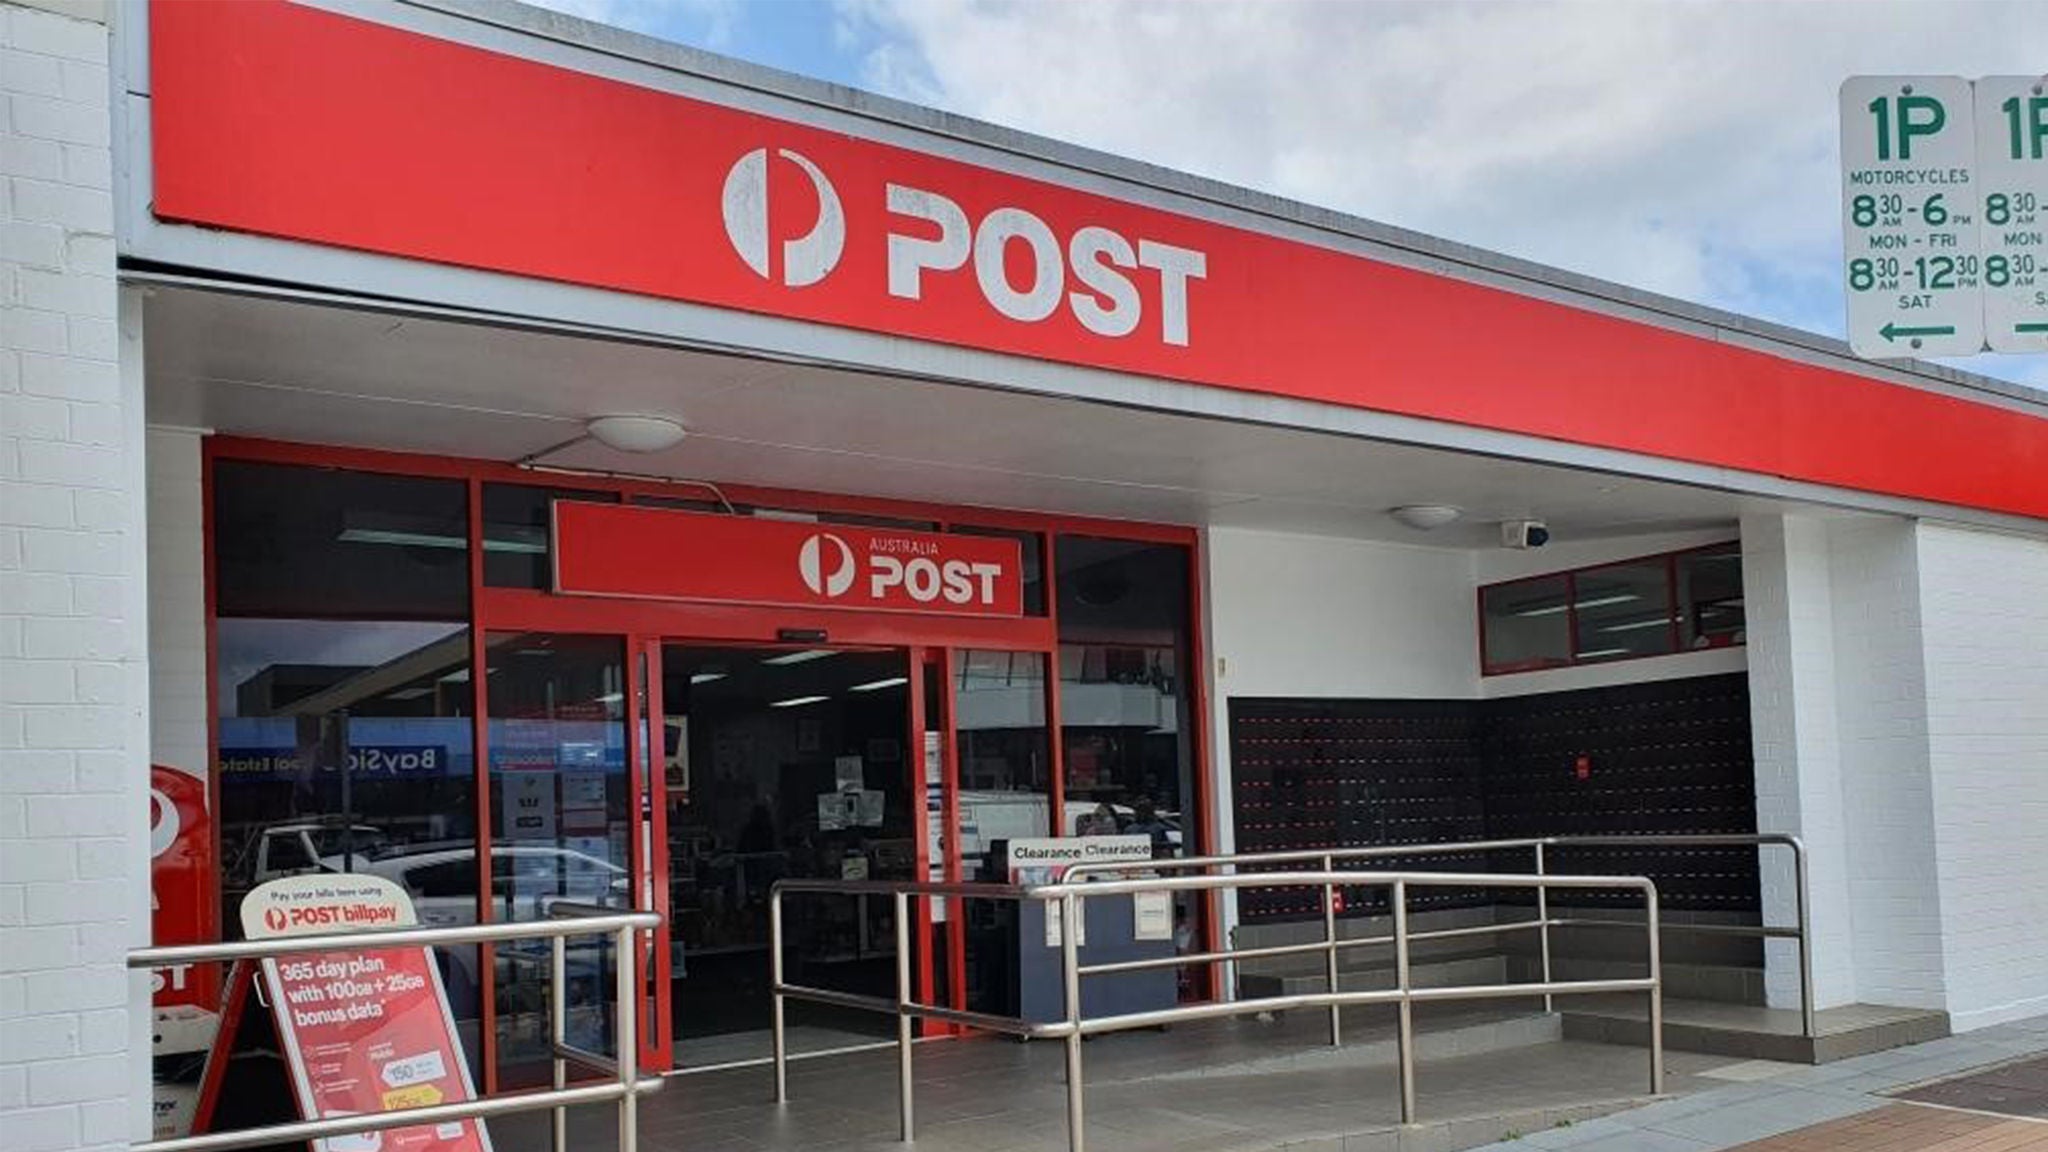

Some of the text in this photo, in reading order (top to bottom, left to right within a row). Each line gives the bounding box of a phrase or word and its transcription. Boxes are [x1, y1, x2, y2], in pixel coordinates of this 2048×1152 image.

[1869, 96, 1946, 160] 1P
[1850, 169, 1969, 185] MOTORCYCLES
[1882, 215, 1972, 227] AM PM
[1870, 235, 1907, 249] MON
[1929, 234, 1957, 247] FRI
[2004, 233, 2042, 247] MON
[886, 182, 1207, 347] POST
[1878, 278, 1978, 291] AM PM
[1899, 295, 1933, 309] SAT
[870, 537, 939, 555] AUSTRALIA
[869, 555, 1001, 604] POST
[1014, 844, 1151, 859] Clearance Clearance
[290, 903, 397, 926] POST billpay
[280, 955, 385, 981] 365 day plan
[288, 984, 325, 1004] with
[294, 1008, 347, 1026] bonus
